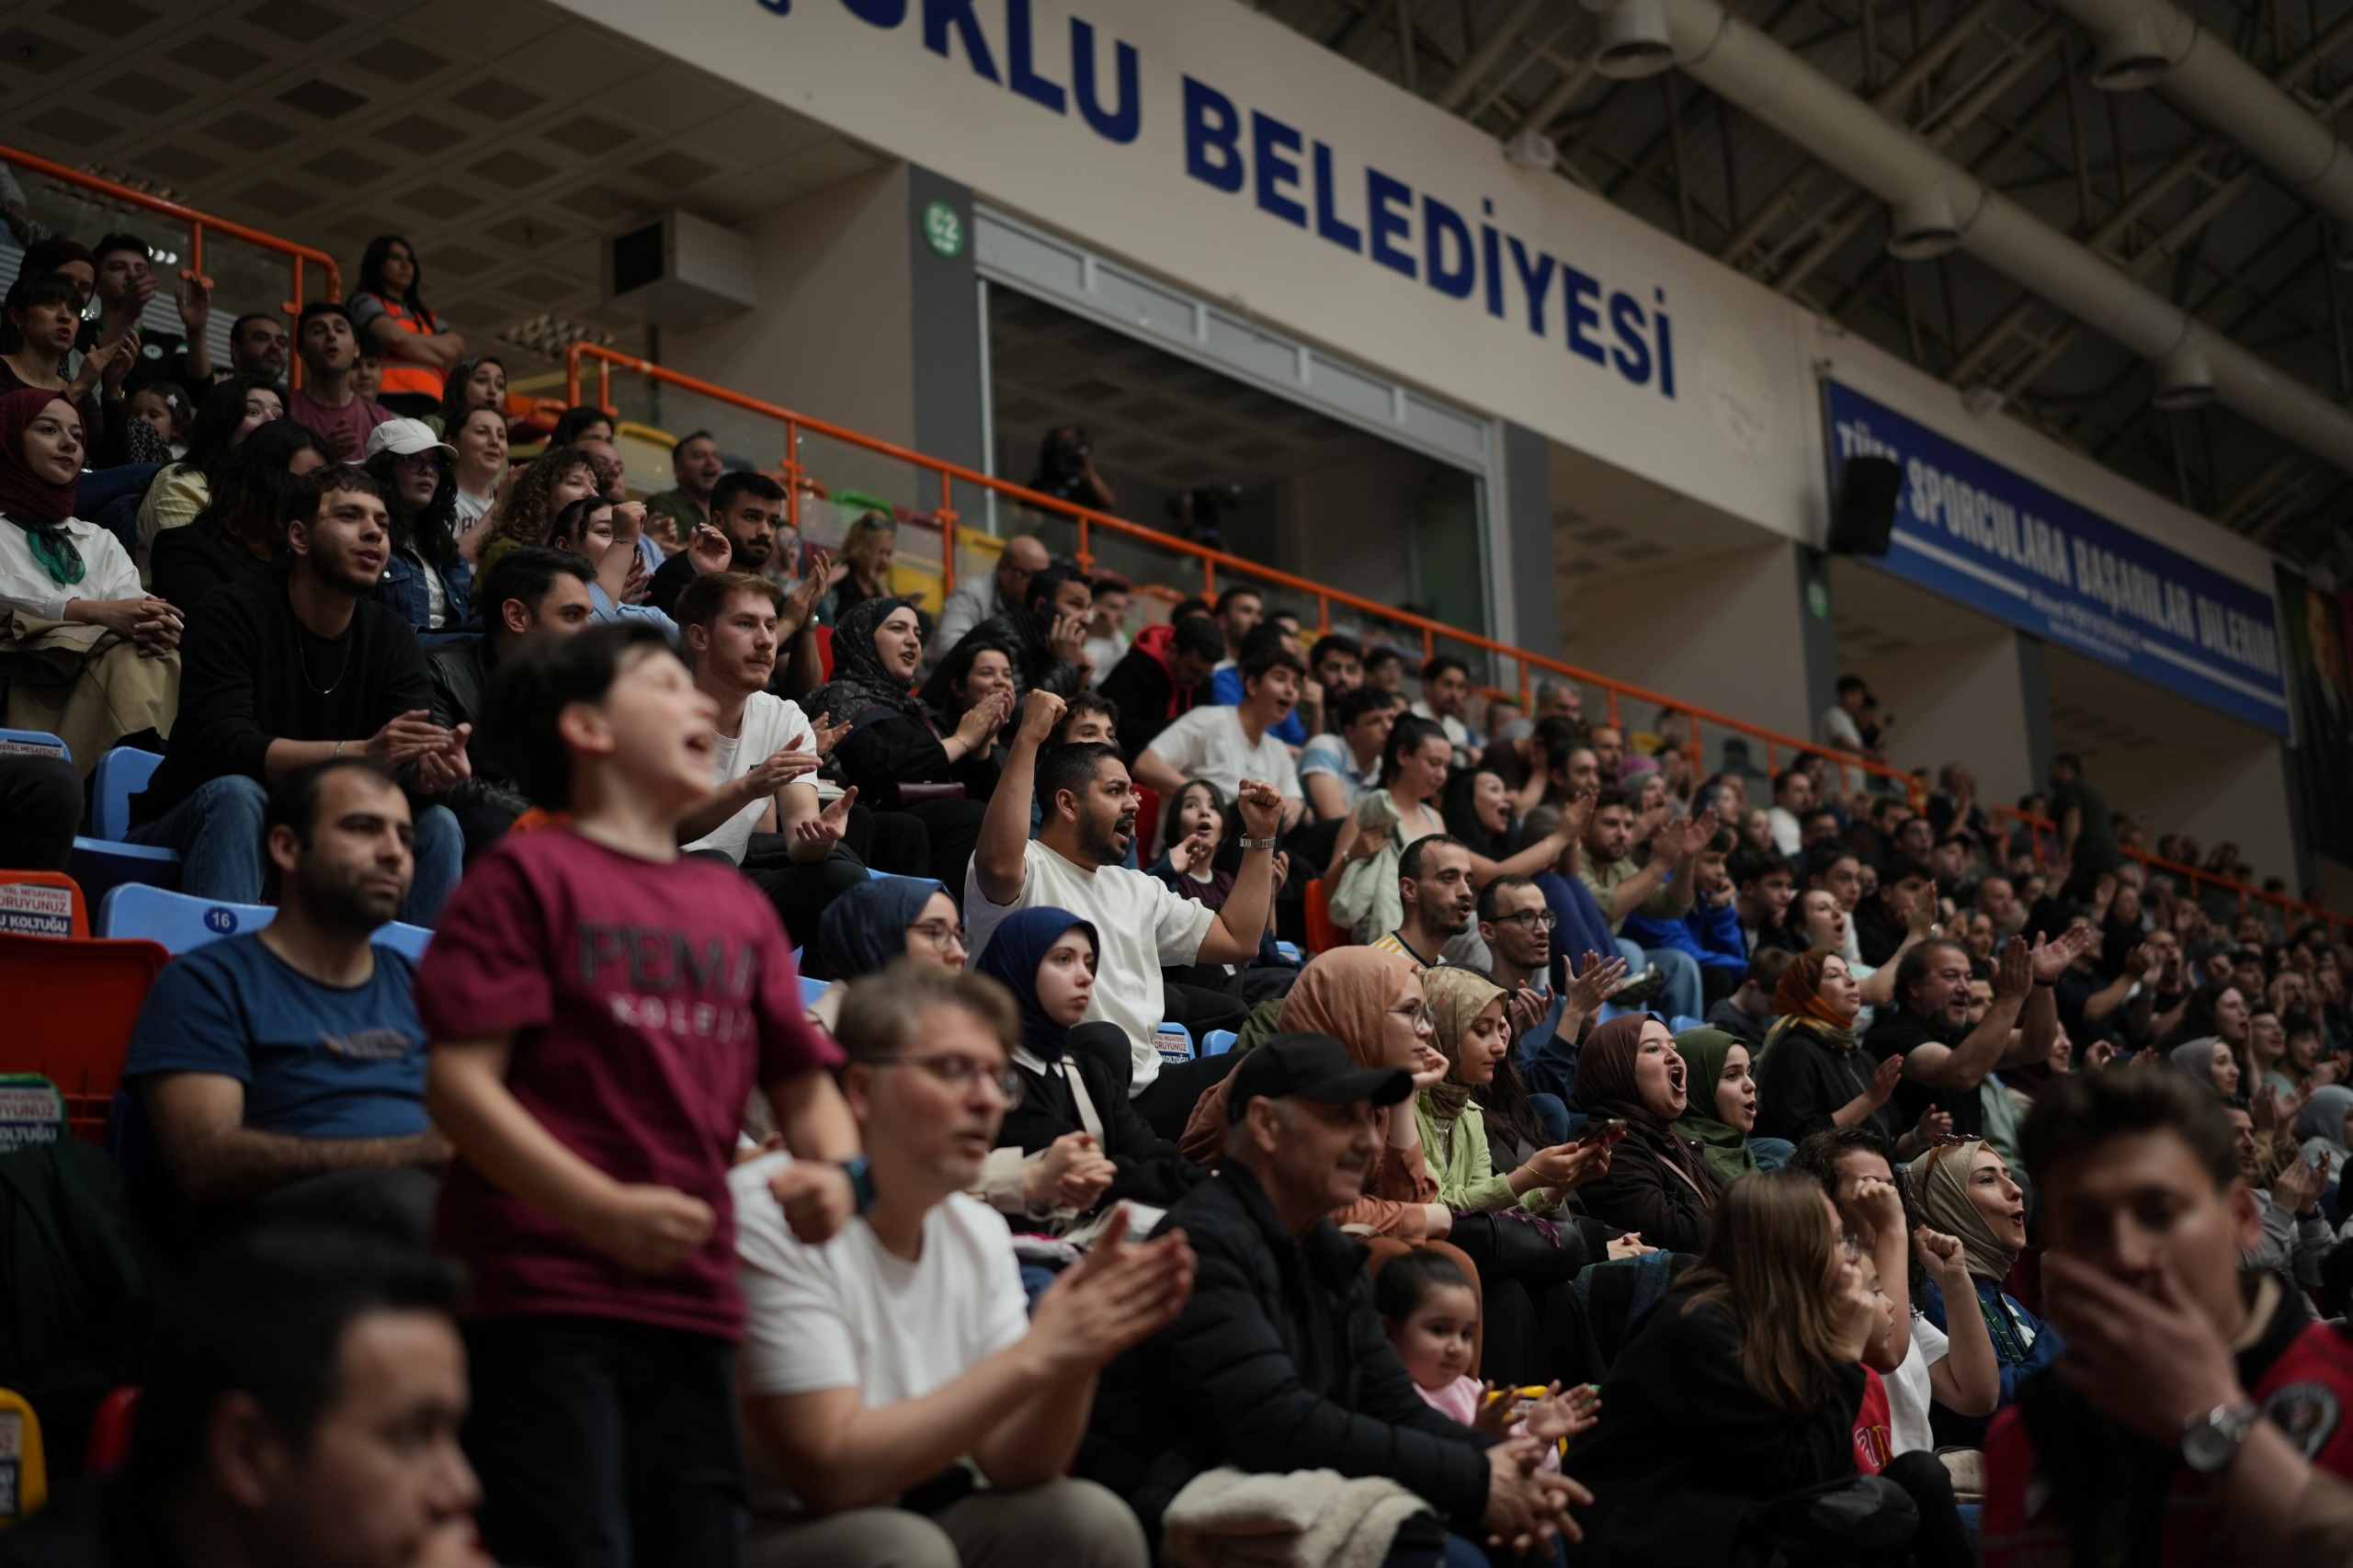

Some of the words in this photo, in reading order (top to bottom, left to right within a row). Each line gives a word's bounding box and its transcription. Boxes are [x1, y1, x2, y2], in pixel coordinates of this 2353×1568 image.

[756, 0, 1142, 144] KLU
[1182, 74, 1676, 401] BELEDİYESİ
[1907, 457, 2072, 586] SPORCULARA
[2074, 536, 2197, 641] BAŞARILAR
[9, 915, 68, 933] KOLTUĞU
[212, 911, 231, 928] 16
